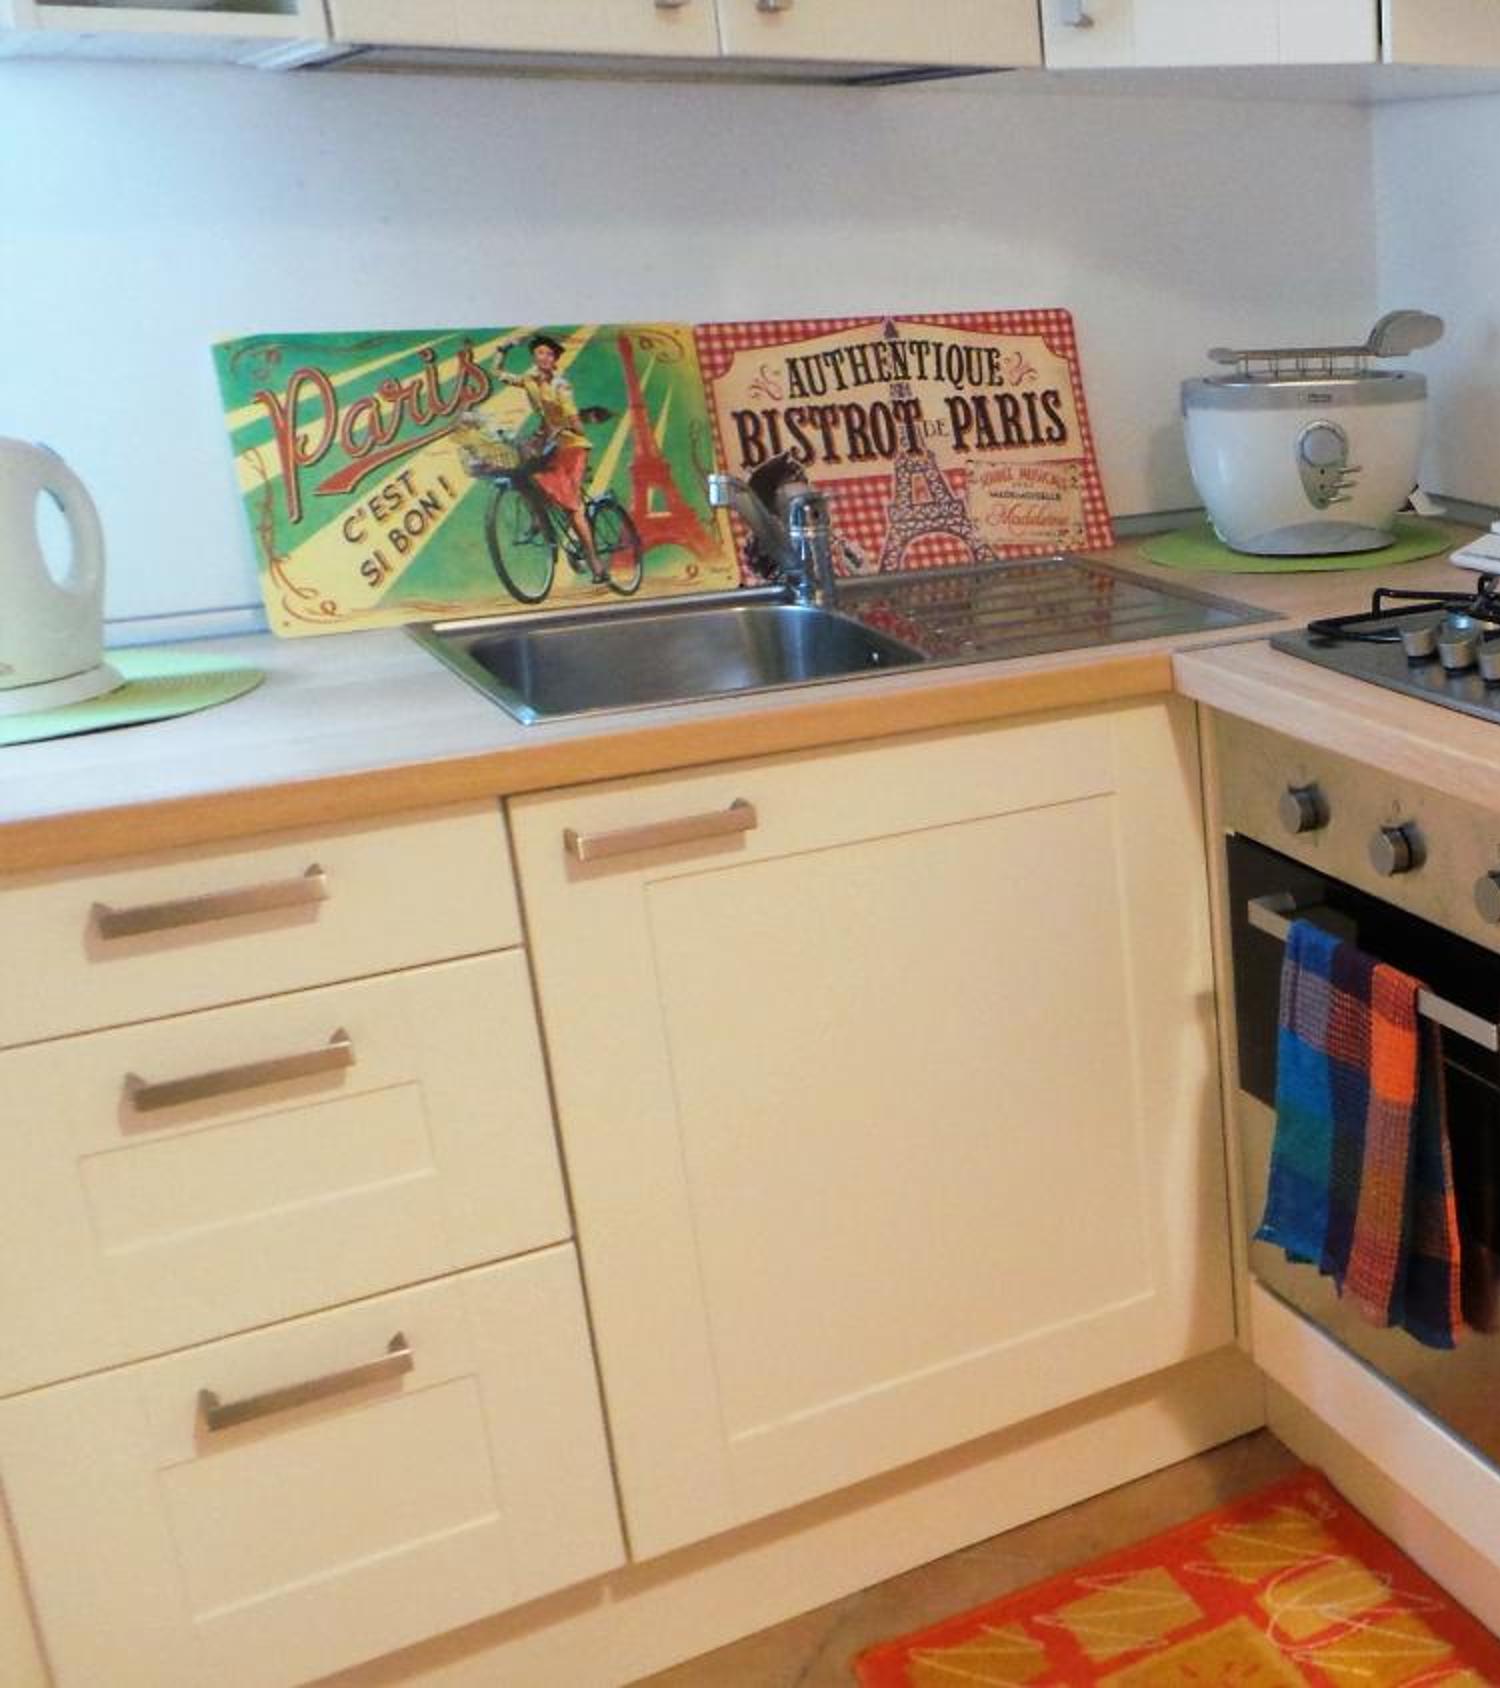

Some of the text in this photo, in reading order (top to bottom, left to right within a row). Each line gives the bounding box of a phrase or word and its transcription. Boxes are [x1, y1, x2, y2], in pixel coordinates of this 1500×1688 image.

[785, 338, 1005, 399] AUTHENTIQUE
[255, 337, 494, 524] Paris
[731, 388, 1067, 469] BISTROT DE PARIS
[342, 469, 416, 543] C'EST
[360, 549, 392, 587] SI
